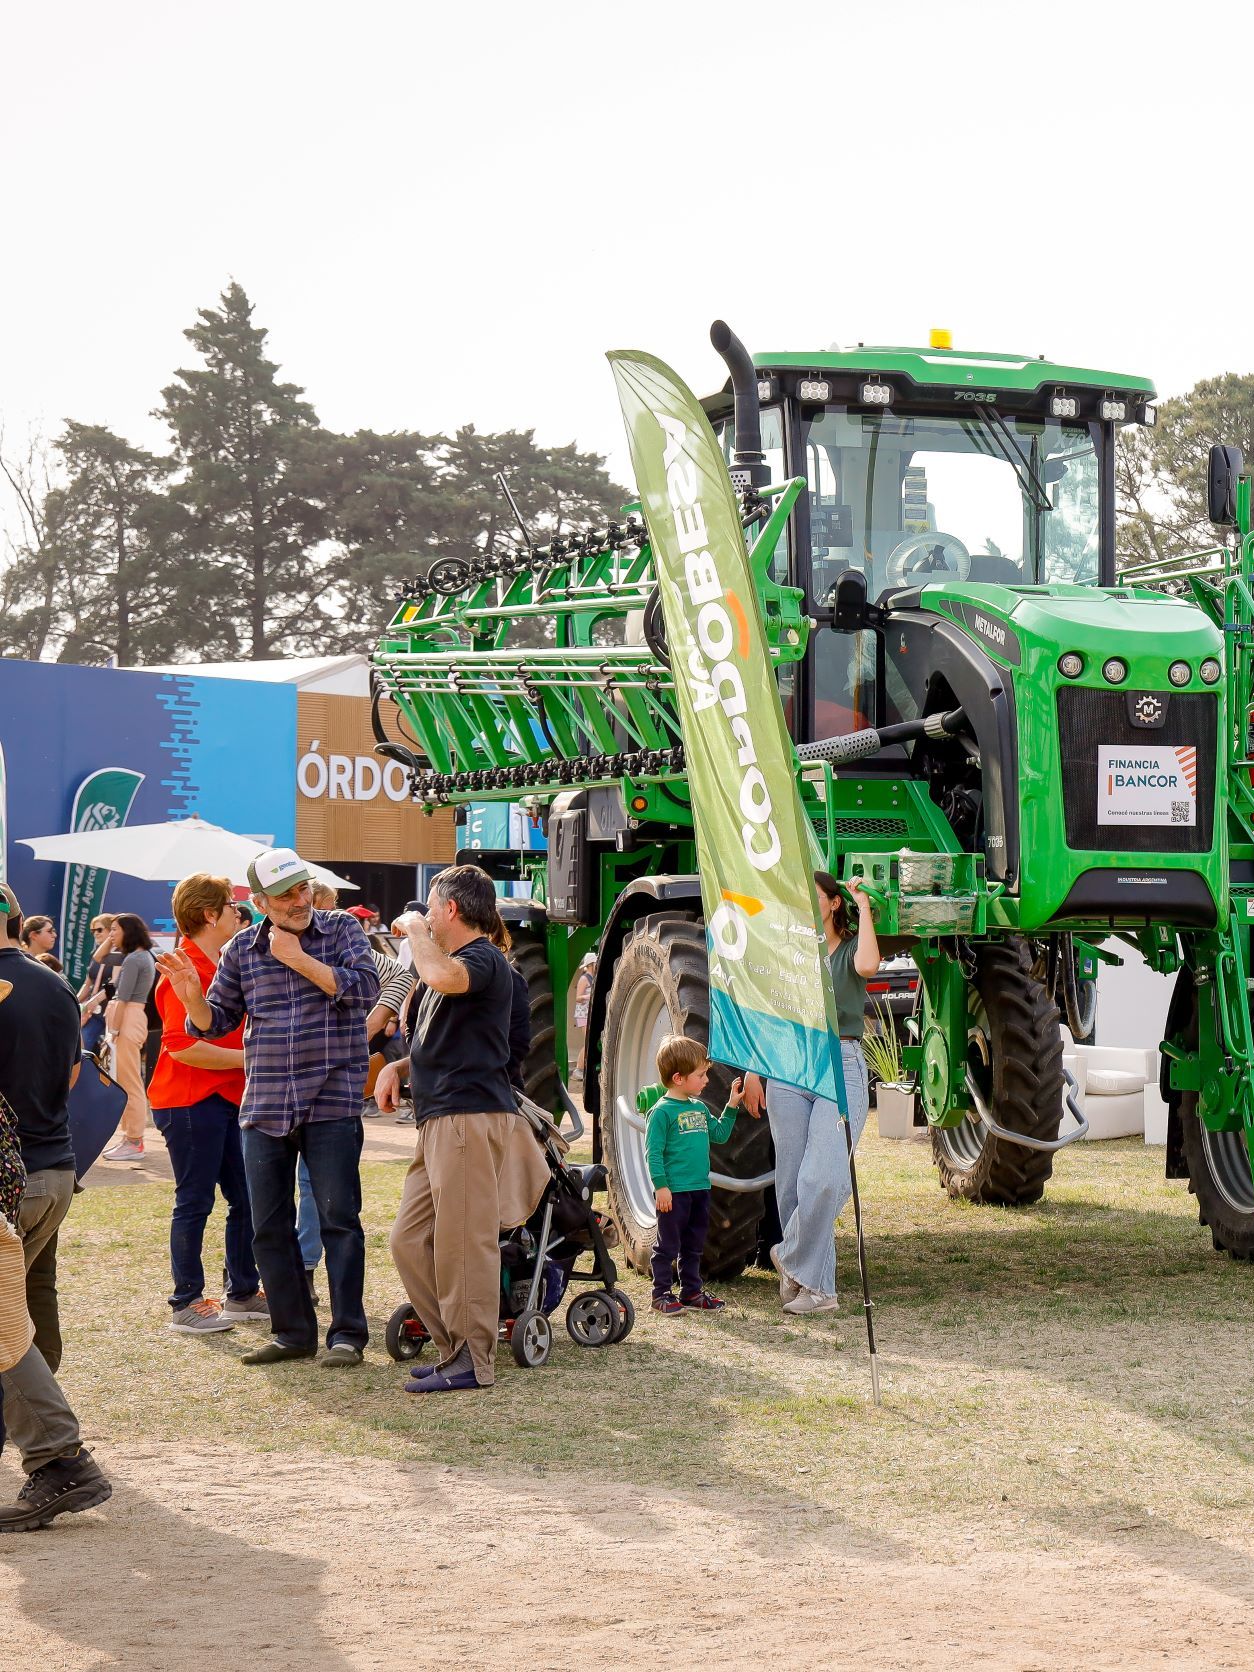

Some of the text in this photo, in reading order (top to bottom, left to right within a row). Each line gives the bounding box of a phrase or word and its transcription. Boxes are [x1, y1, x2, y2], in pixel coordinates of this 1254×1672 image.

[954, 391, 997, 403] 7035
[974, 614, 1006, 646] METALFOR
[297, 740, 415, 802] ÓRDO
[1108, 759, 1160, 770] FINANCIA
[1115, 774, 1178, 788] BANCOR
[987, 836, 1004, 848] 7035
[72, 865, 99, 979] Implementos Agrícol
[881, 992, 917, 1000] POLARIS
